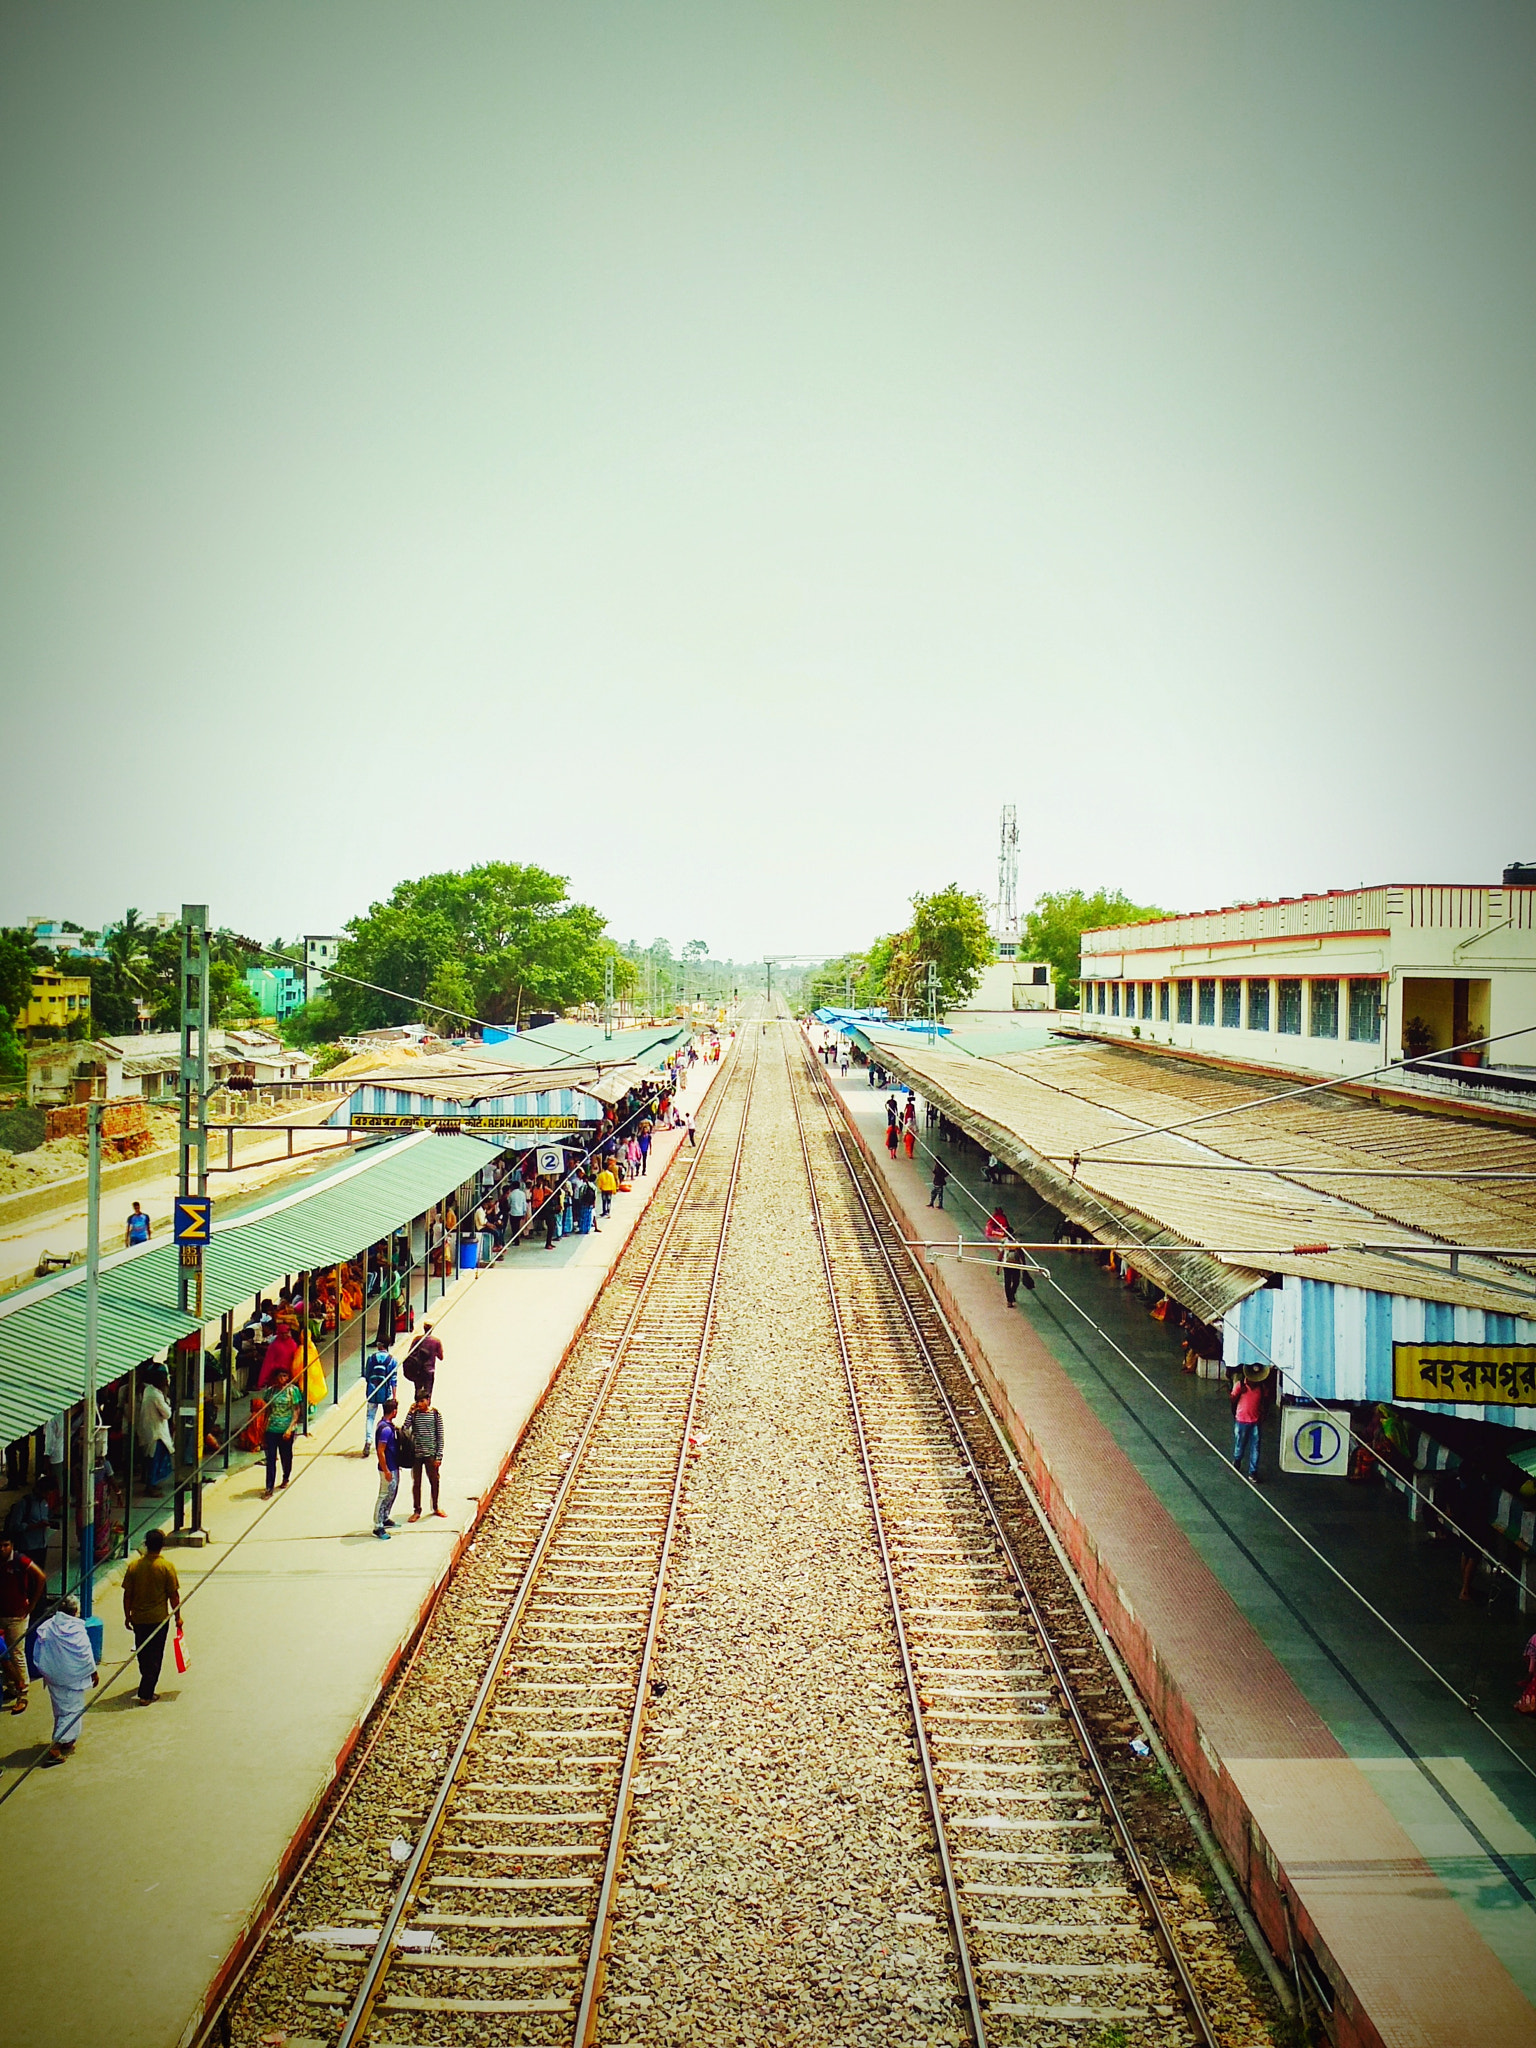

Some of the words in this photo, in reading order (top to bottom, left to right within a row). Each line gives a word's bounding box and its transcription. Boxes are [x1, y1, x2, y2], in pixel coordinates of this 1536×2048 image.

[549, 1119, 579, 1129] COURT
[544, 1155, 557, 1168] 2
[1418, 1358, 1536, 1400] বহরমপুর
[1308, 1425, 1324, 1459] 1
